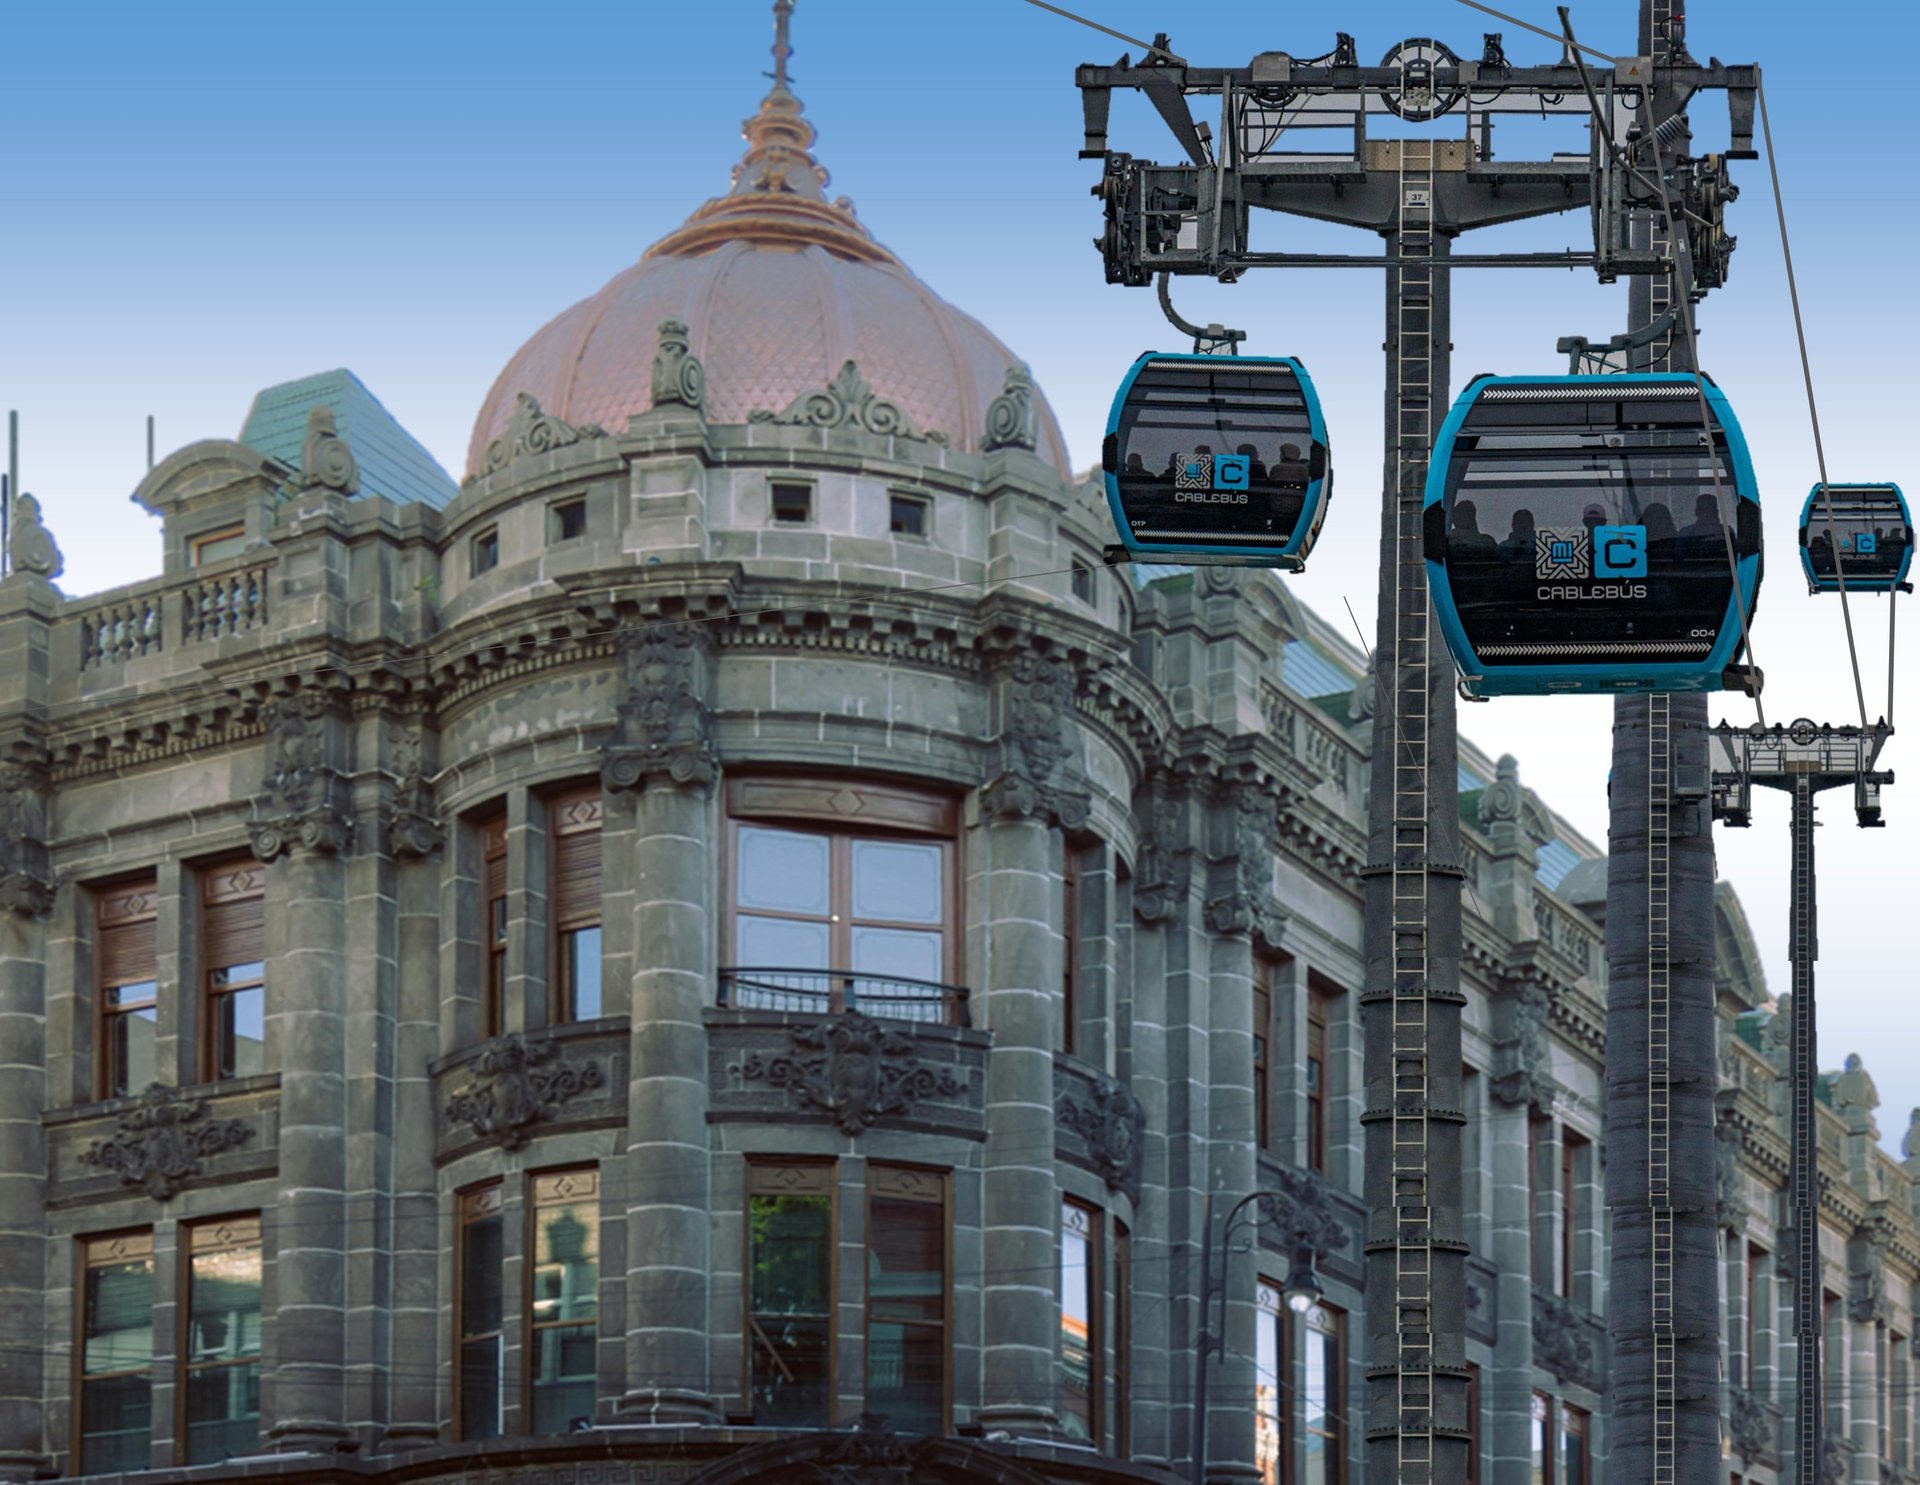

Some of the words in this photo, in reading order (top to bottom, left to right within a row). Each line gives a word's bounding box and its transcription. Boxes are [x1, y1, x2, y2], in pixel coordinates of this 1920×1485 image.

[1221, 464, 1242, 483] C
[1175, 491, 1248, 504] CABLEBÚS
[1605, 539, 1637, 568] C
[1537, 580, 1647, 600] CABLEBÚS
[1690, 629, 1715, 637] 004
